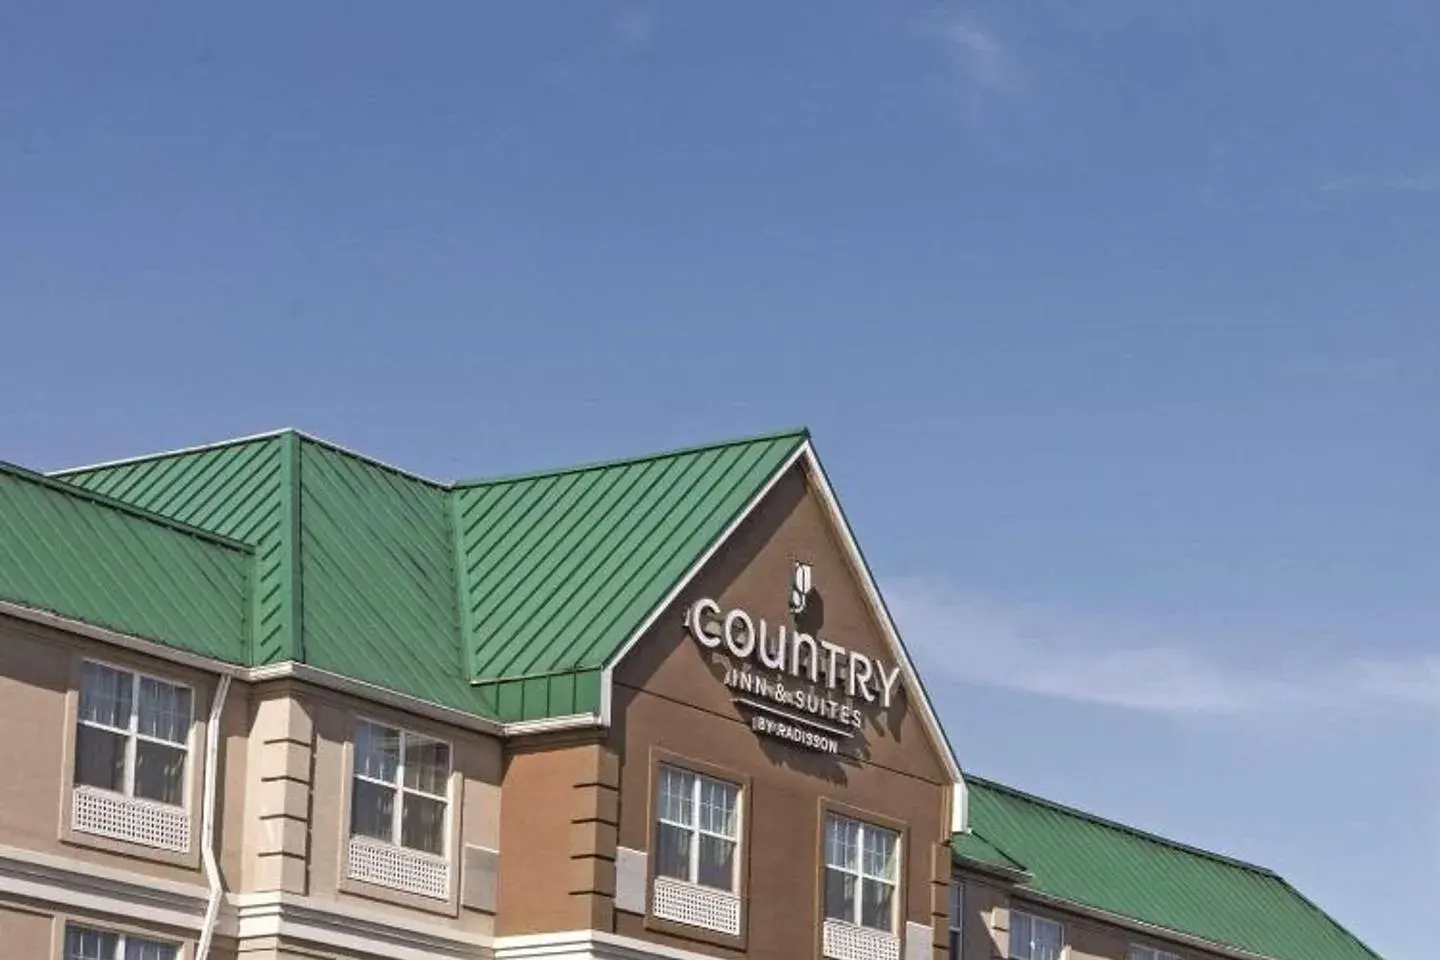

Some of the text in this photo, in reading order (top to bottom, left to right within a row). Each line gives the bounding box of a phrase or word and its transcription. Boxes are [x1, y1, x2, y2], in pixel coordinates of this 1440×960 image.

[731, 669, 861, 729] INN & SUITES
[757, 716, 838, 754] BY RADISSON
